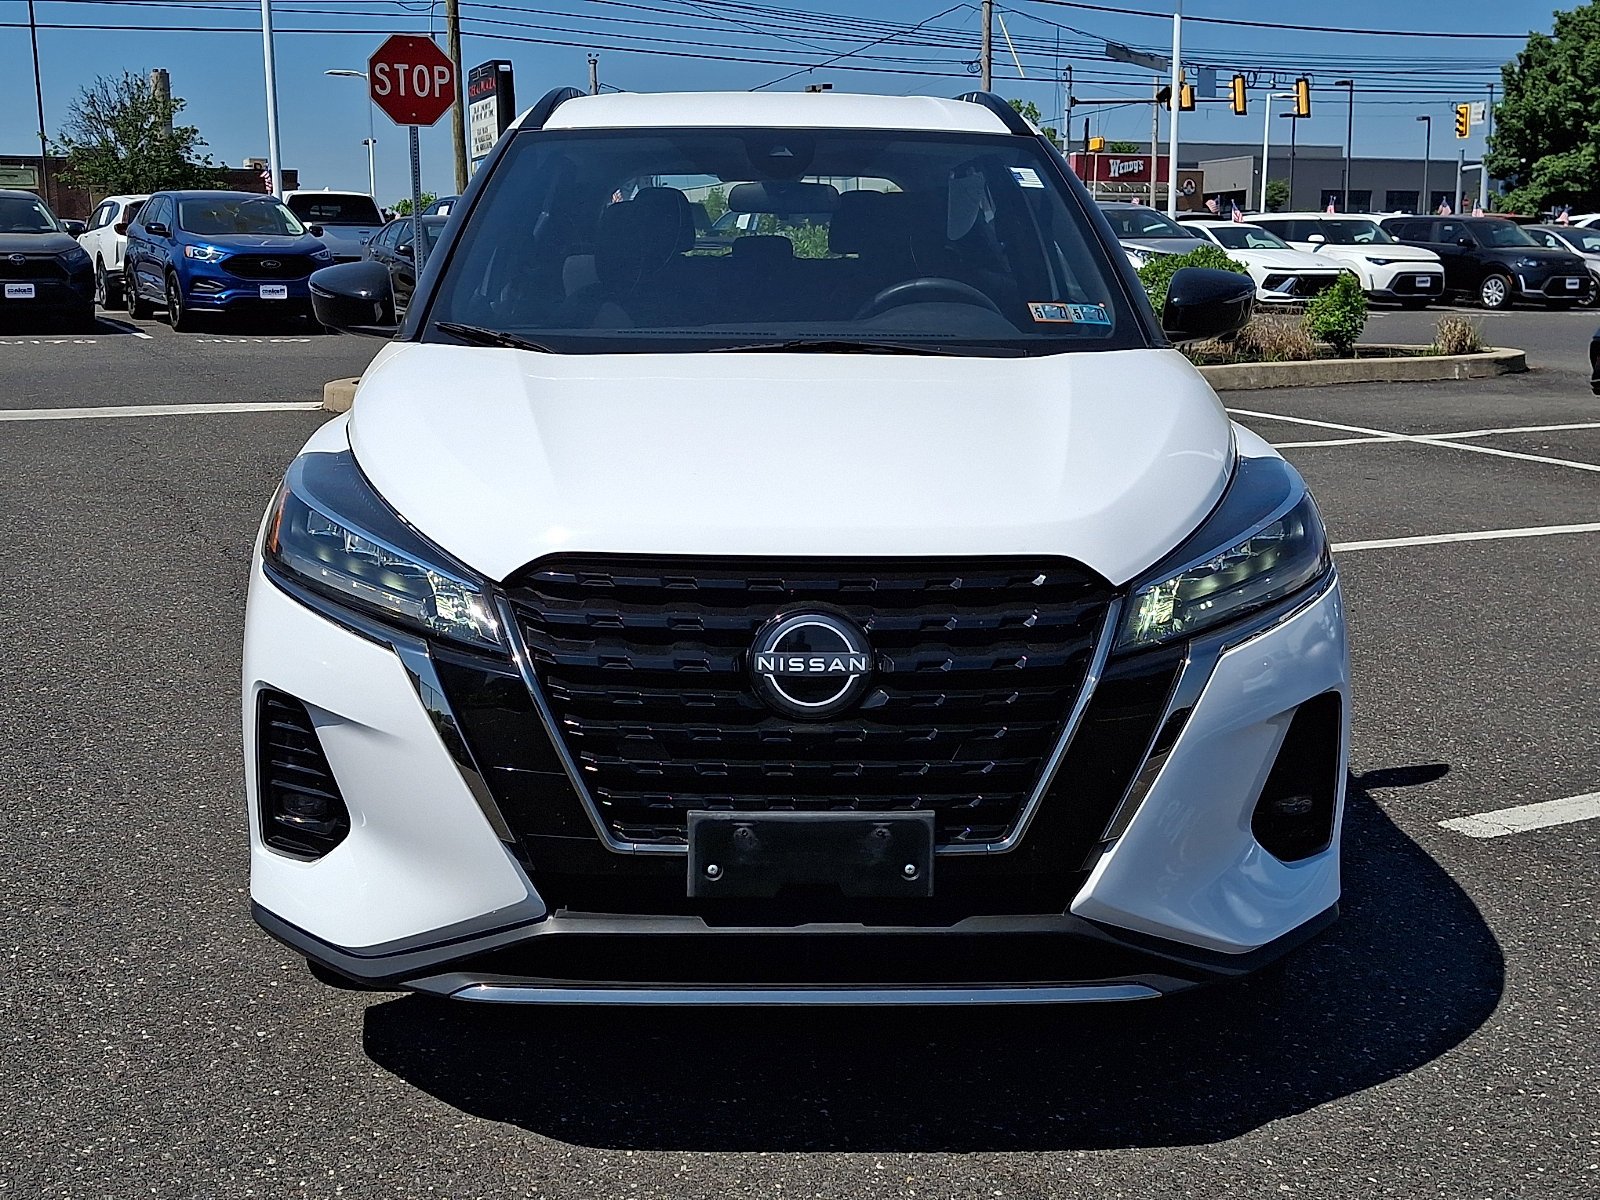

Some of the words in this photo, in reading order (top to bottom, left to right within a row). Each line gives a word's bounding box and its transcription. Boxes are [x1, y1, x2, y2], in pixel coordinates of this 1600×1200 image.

[374, 62, 450, 98] STOP
[1109, 159, 1144, 178] Wendy's
[1034, 307, 1043, 318] 5
[1073, 308, 1082, 320] 5
[757, 656, 867, 672] NISSAN
